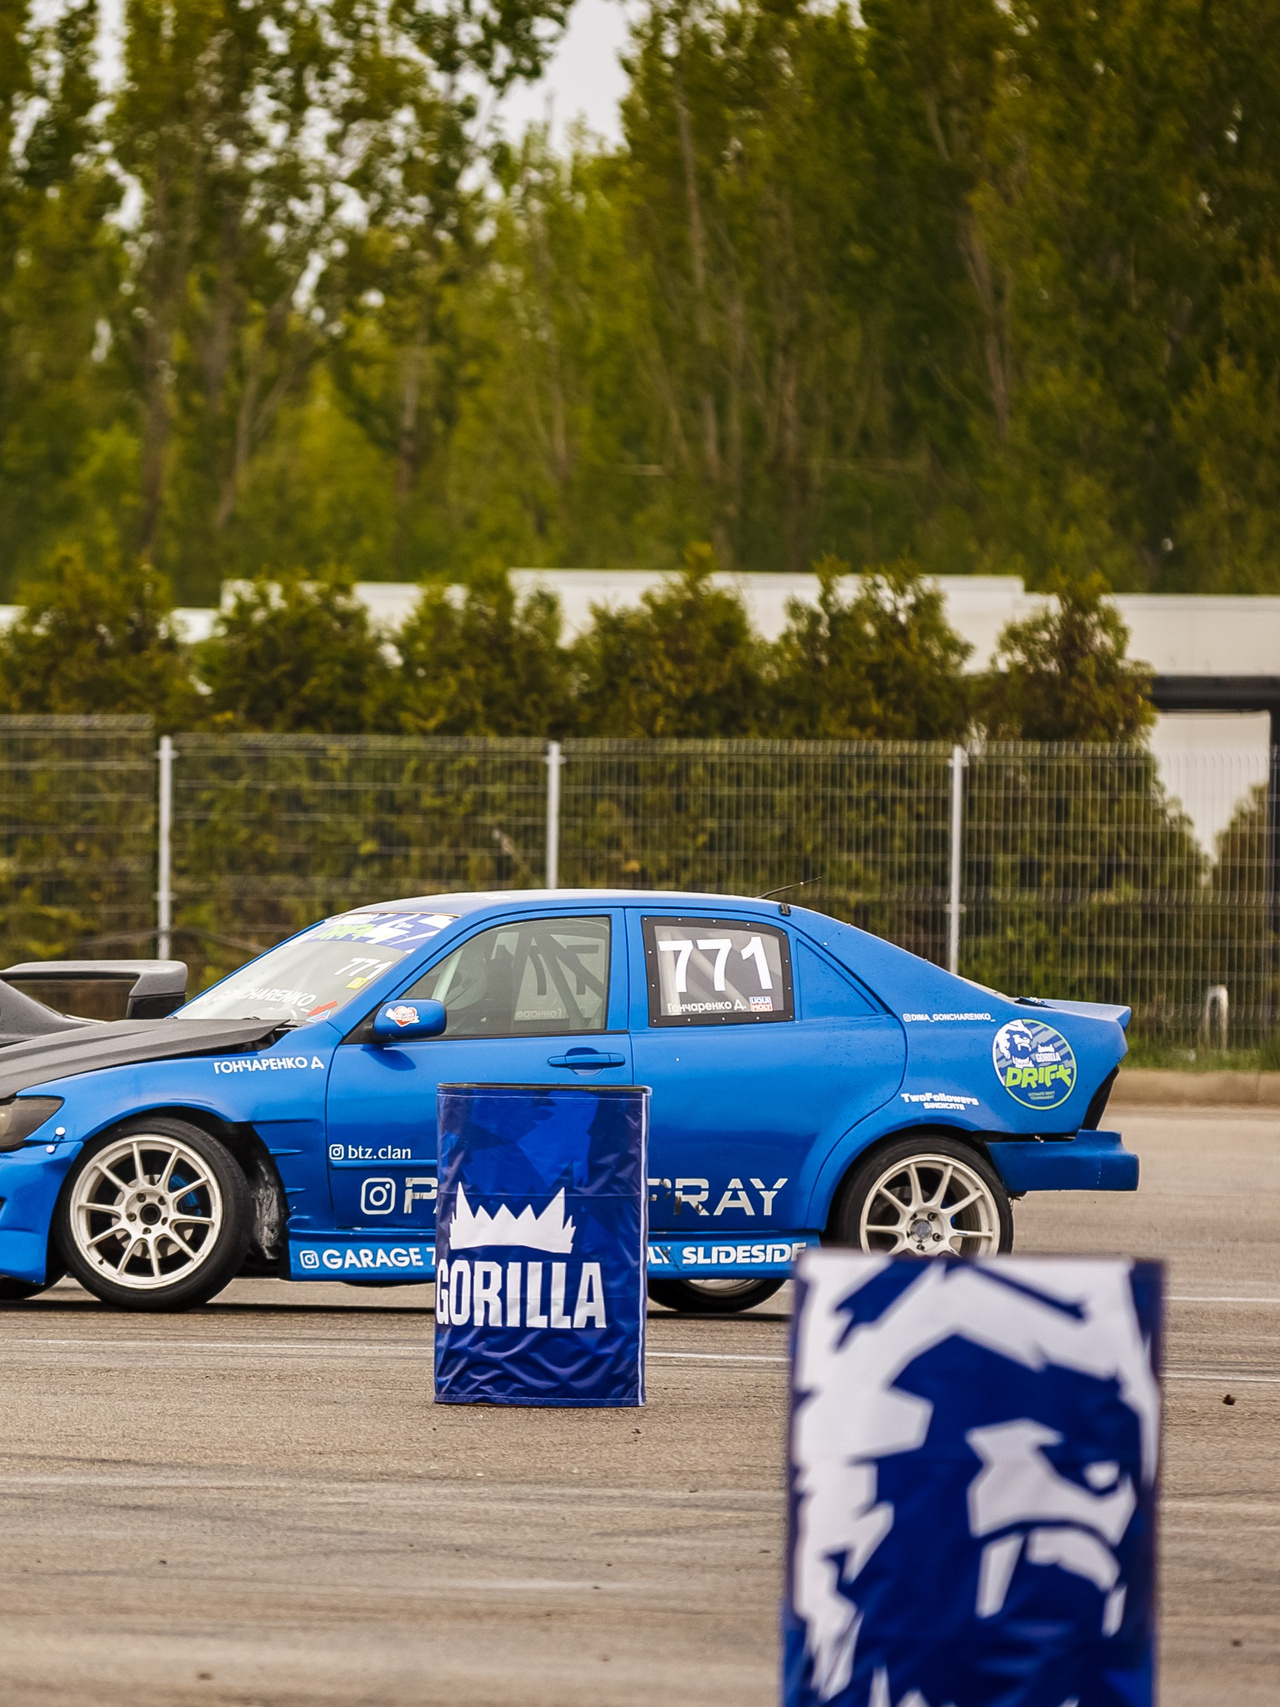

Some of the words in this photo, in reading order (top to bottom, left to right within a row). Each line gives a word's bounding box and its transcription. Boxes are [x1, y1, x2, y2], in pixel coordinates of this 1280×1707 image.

[334, 957, 394, 980] 771
[658, 936, 773, 993] 771
[667, 1001, 733, 1013] Гончаренко
[213, 1057, 308, 1075] ГОНЧАРЕНКО
[310, 1056, 325, 1070] Д
[1005, 1064, 1072, 1089] DRIFT
[901, 1092, 979, 1106] TwoFollowers
[347, 1145, 412, 1159] btz.clan
[322, 1247, 424, 1269] GARAGE
[436, 1259, 607, 1329] GORILLA
